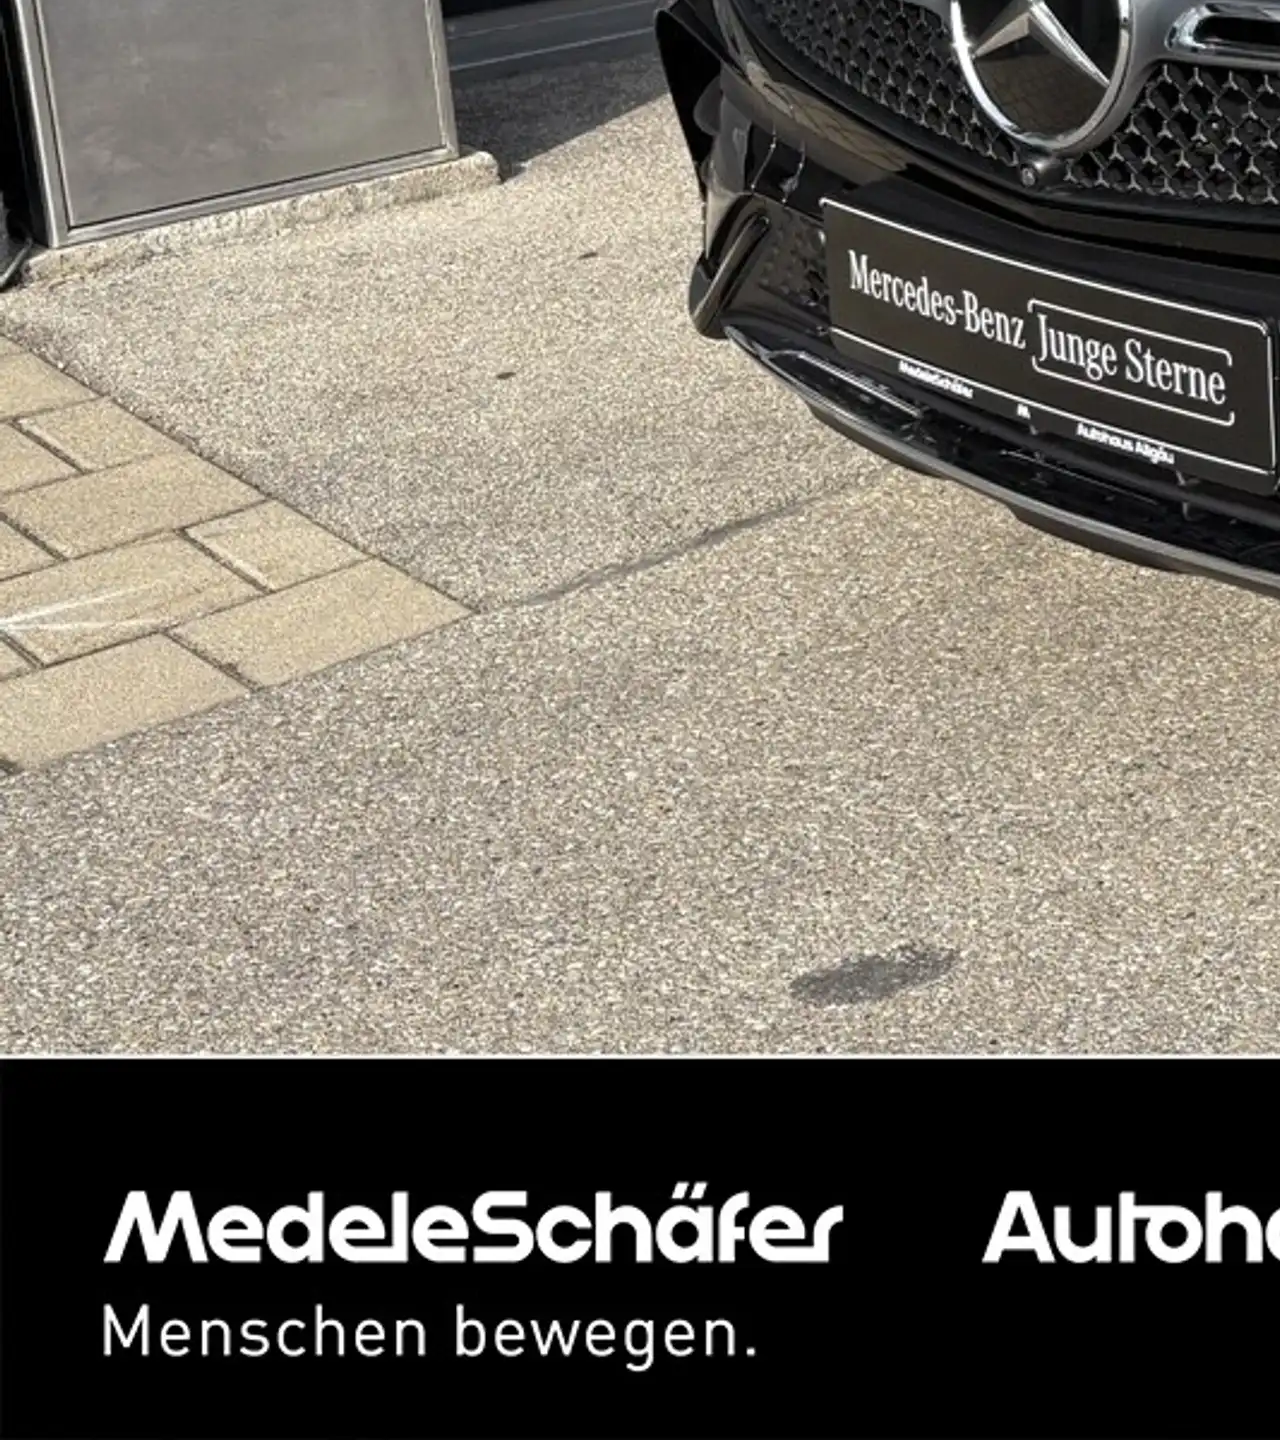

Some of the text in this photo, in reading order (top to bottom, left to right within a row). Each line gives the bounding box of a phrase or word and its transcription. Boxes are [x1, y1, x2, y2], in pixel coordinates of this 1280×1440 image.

[847, 249, 1027, 349] Mercedes-Benz
[1037, 313, 1226, 405] Junge Sterne
